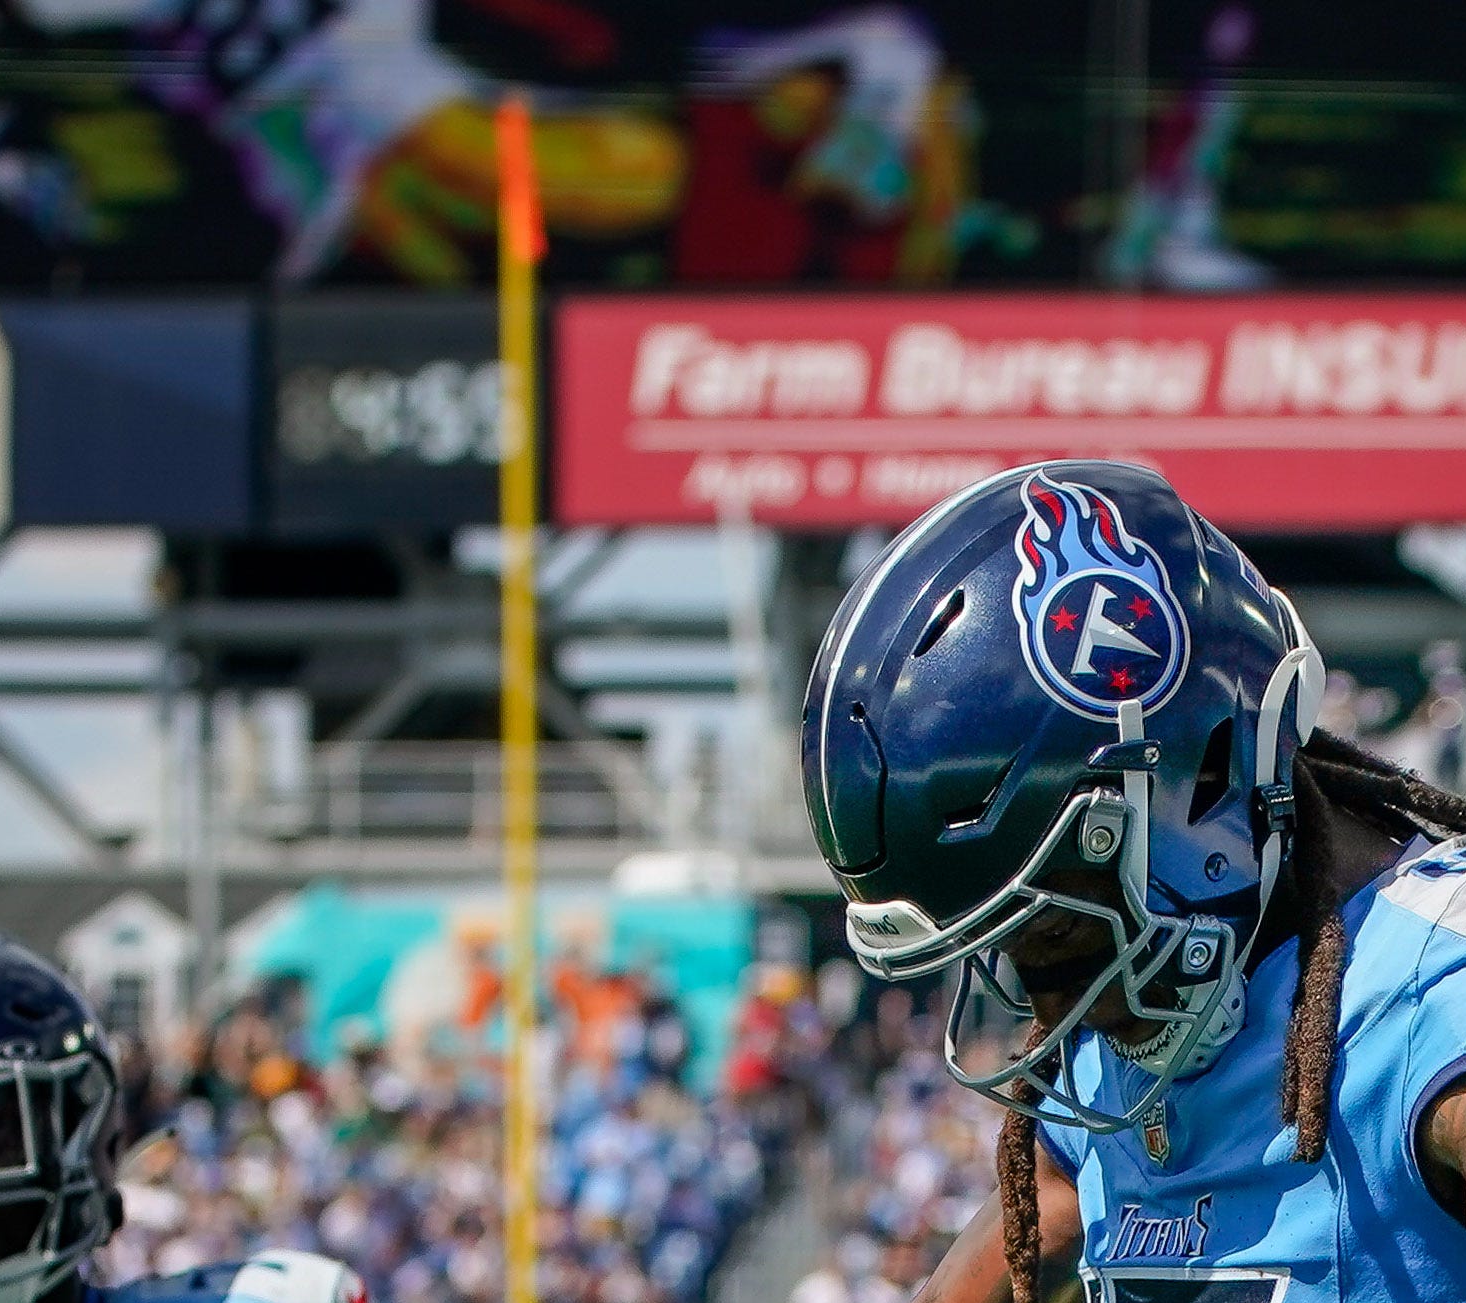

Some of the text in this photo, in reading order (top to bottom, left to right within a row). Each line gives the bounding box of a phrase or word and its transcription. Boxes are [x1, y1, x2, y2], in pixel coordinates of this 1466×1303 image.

[632, 323, 868, 416] Farm
[884, 323, 1211, 416] Bureau
[1106, 1192, 1214, 1262] TITANS
